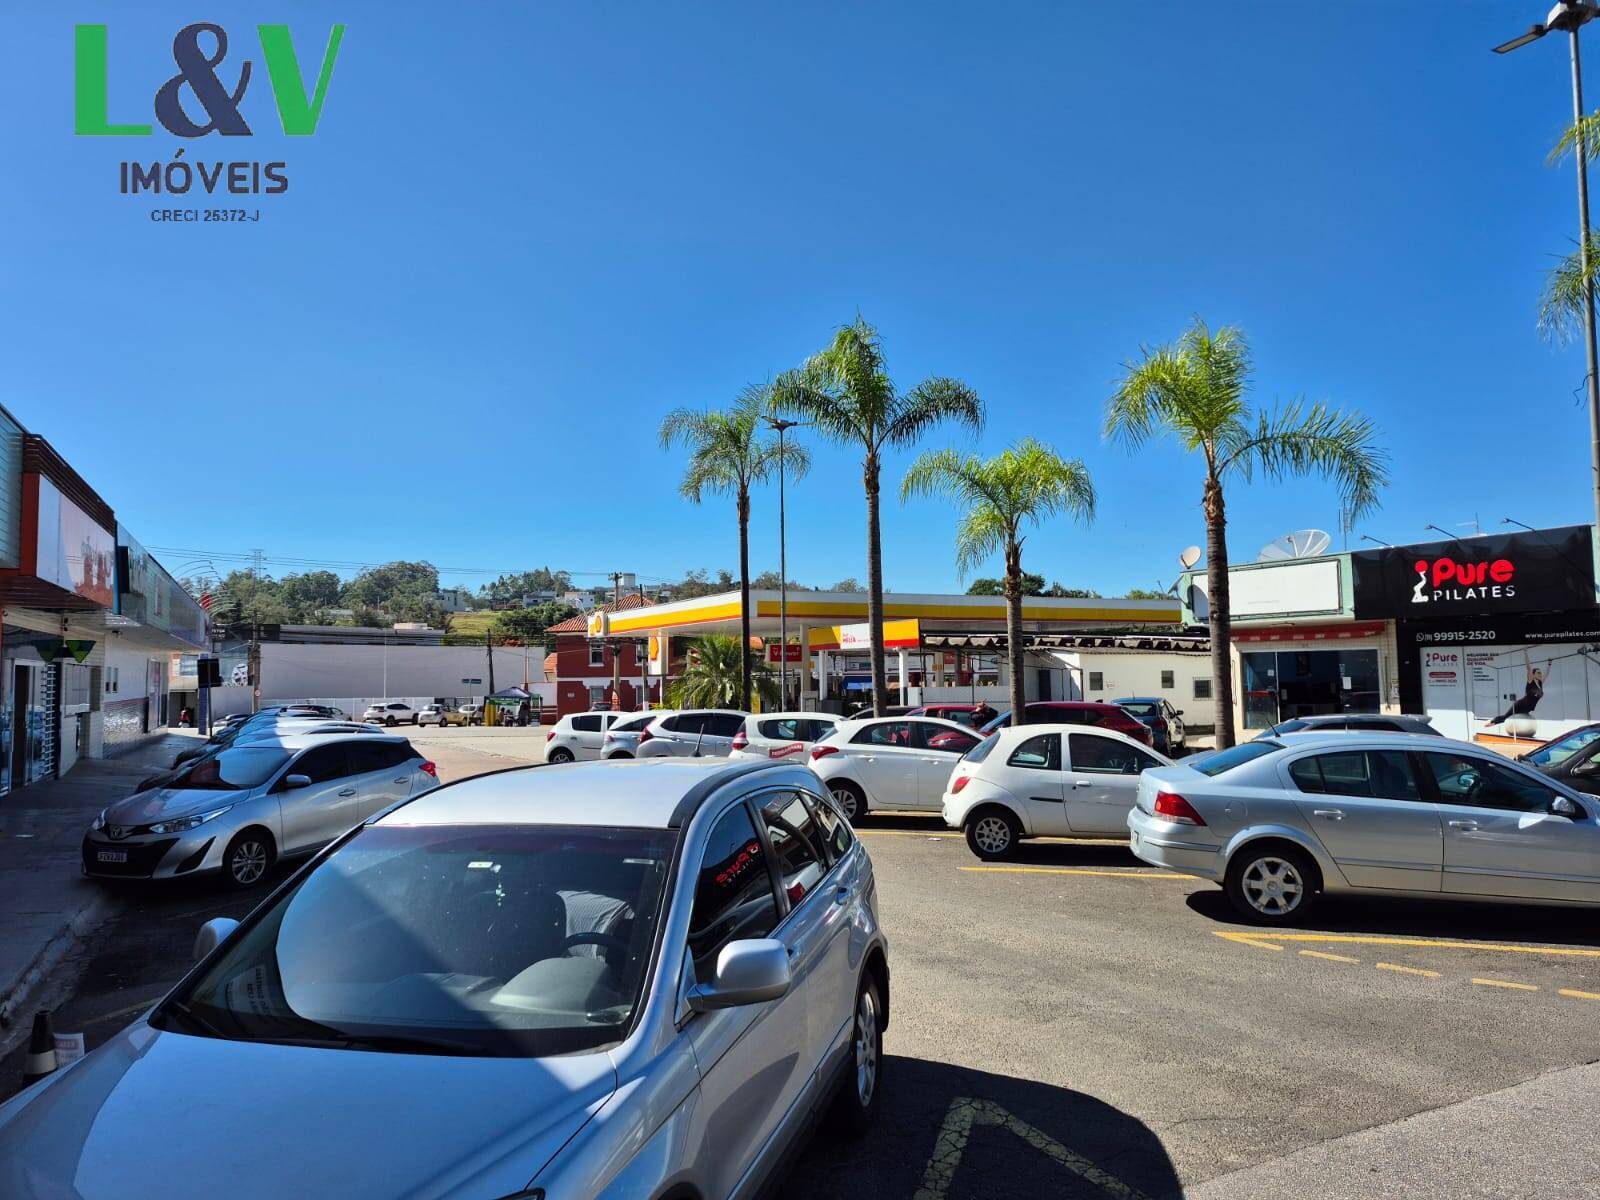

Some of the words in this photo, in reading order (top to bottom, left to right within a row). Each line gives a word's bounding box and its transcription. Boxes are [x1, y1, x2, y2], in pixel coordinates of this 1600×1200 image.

[1432, 558, 1514, 588] Pure
[1433, 586, 1516, 601] PILATES
[1434, 631, 1496, 641] 99915-2520
[1432, 653, 1458, 662] Pure
